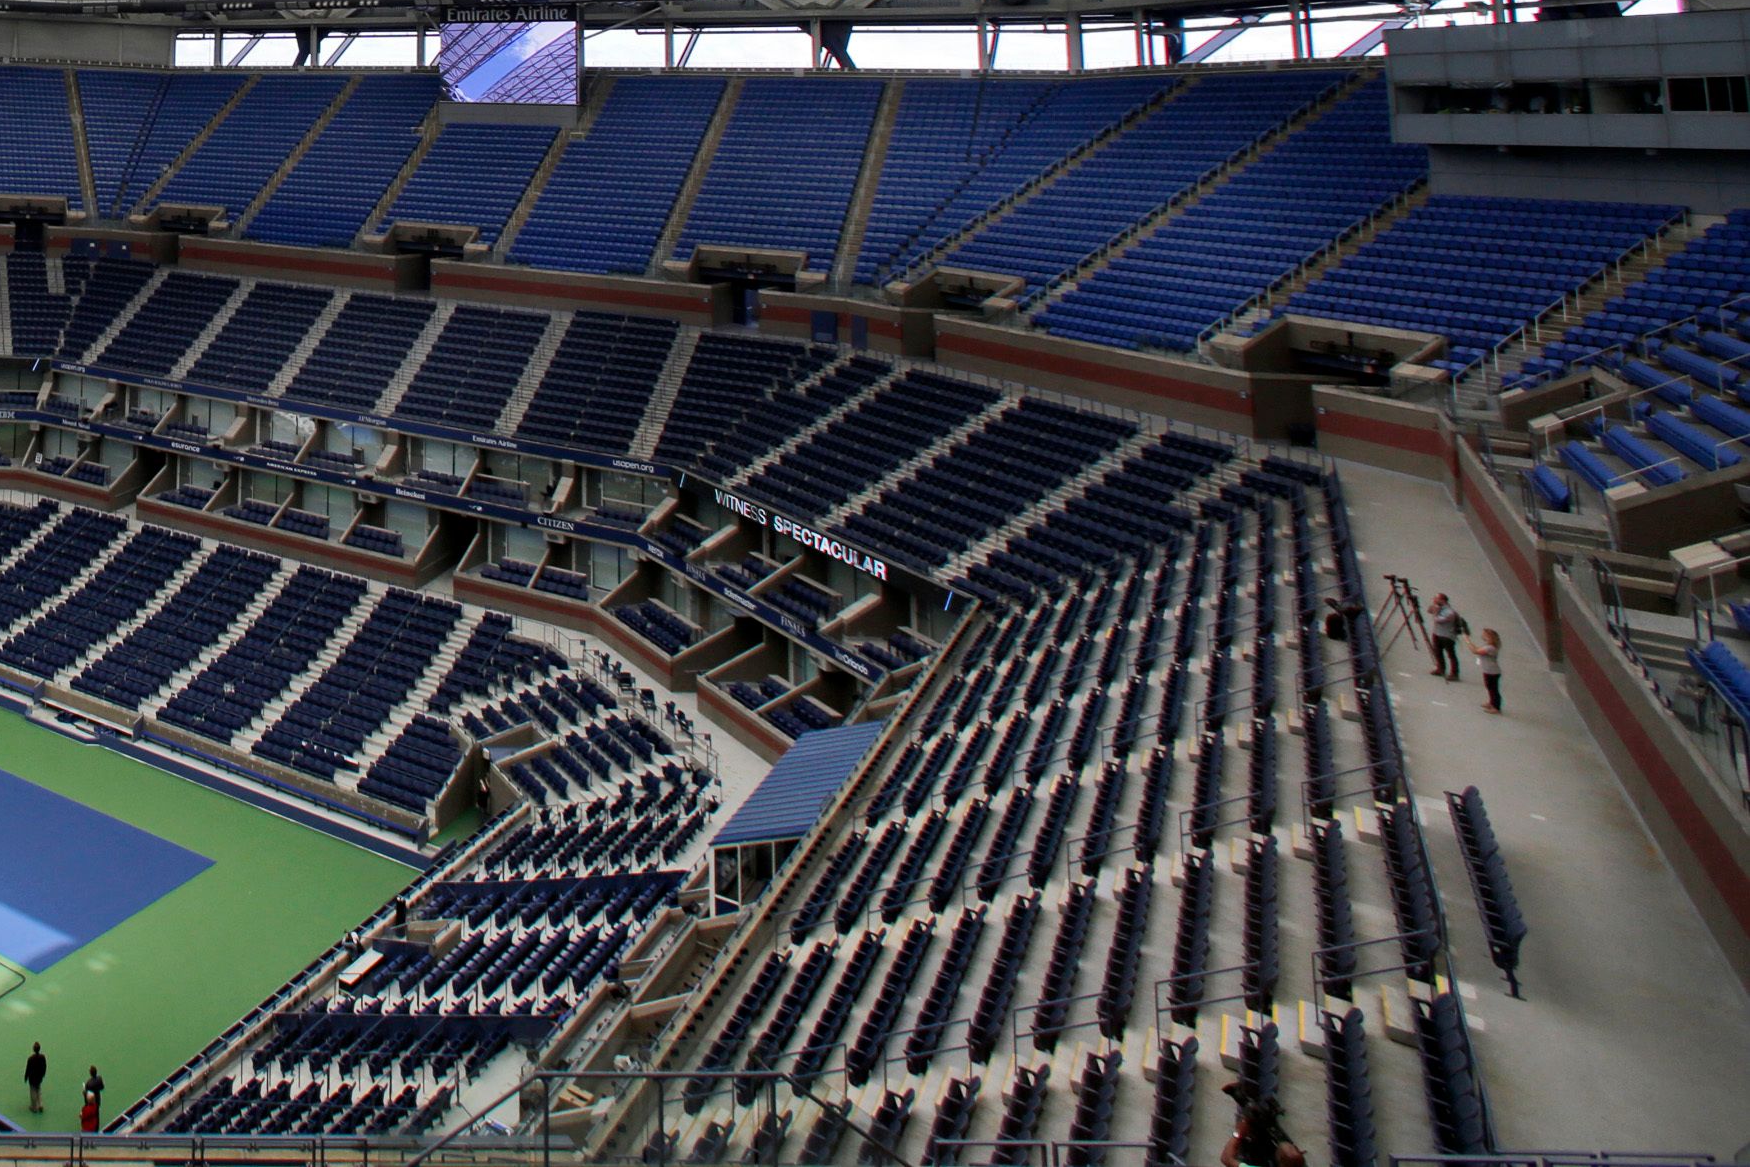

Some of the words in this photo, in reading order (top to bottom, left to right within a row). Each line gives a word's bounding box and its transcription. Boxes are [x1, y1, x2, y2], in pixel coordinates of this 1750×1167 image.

[447, 7, 511, 22] Emirates
[515, 5, 568, 20] Airline
[171, 441, 201, 453] esurance
[472, 434, 497, 445] Emirates
[498, 439, 518, 449] Airline
[266, 462, 293, 471] AMERICAN
[294, 467, 317, 477] EXPRESS
[612, 459, 655, 474] usopen.org
[395, 487, 426, 500] Heineken
[537, 516, 575, 531] CITIZEN
[714, 489, 768, 526] WITNESS
[773, 515, 889, 581] SPECTACULAR
